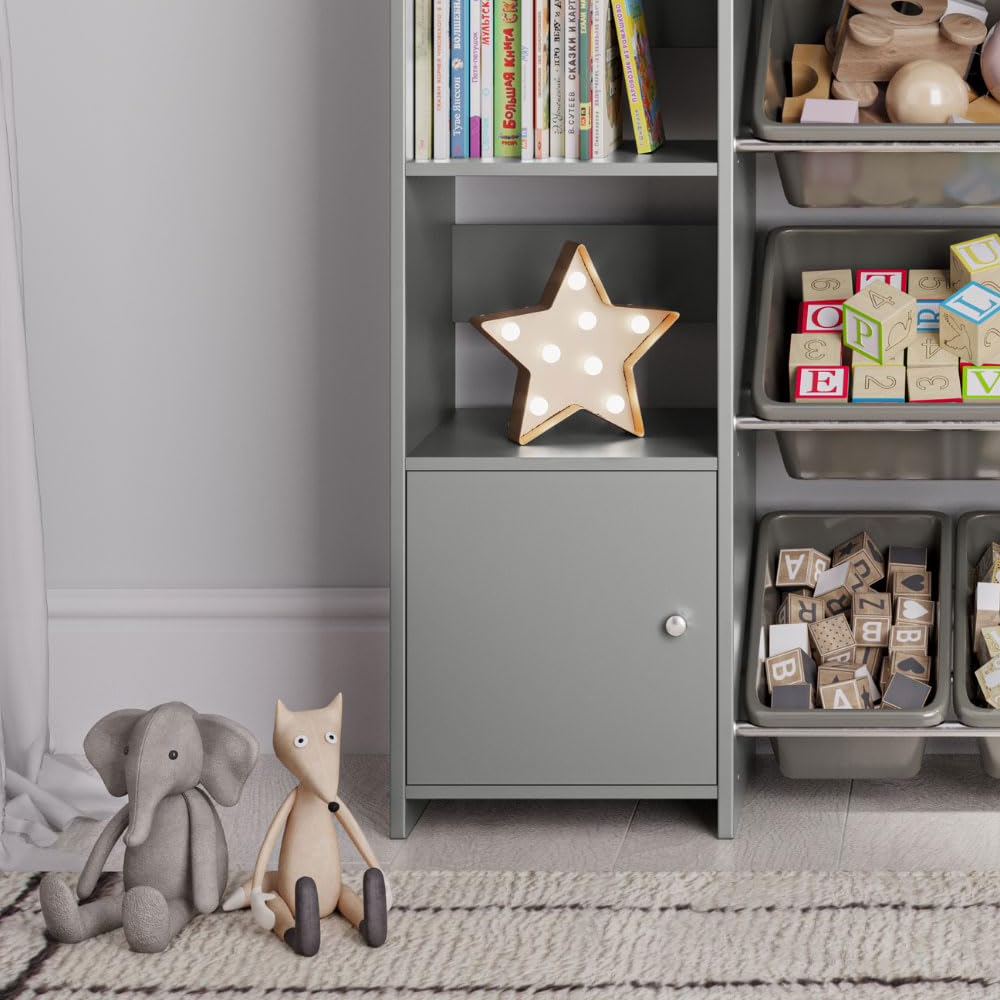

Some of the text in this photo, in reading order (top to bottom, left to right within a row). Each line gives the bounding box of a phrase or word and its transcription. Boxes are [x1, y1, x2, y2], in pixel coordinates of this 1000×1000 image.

[568, 37, 577, 81] СКАЗКИ
[452, 76, 463, 136] Туве Янссон
[958, 239, 1000, 265] U
[868, 290, 895, 310] 4
[953, 296, 998, 317] L
[852, 315, 873, 347] P
[806, 370, 838, 393] E
[864, 375, 897, 390] 2
[916, 375, 950, 391] 3
[784, 554, 806, 581] A
[799, 599, 817, 623] R
[863, 621, 882, 642] B
[896, 629, 920, 642] B
[772, 657, 797, 681] B
